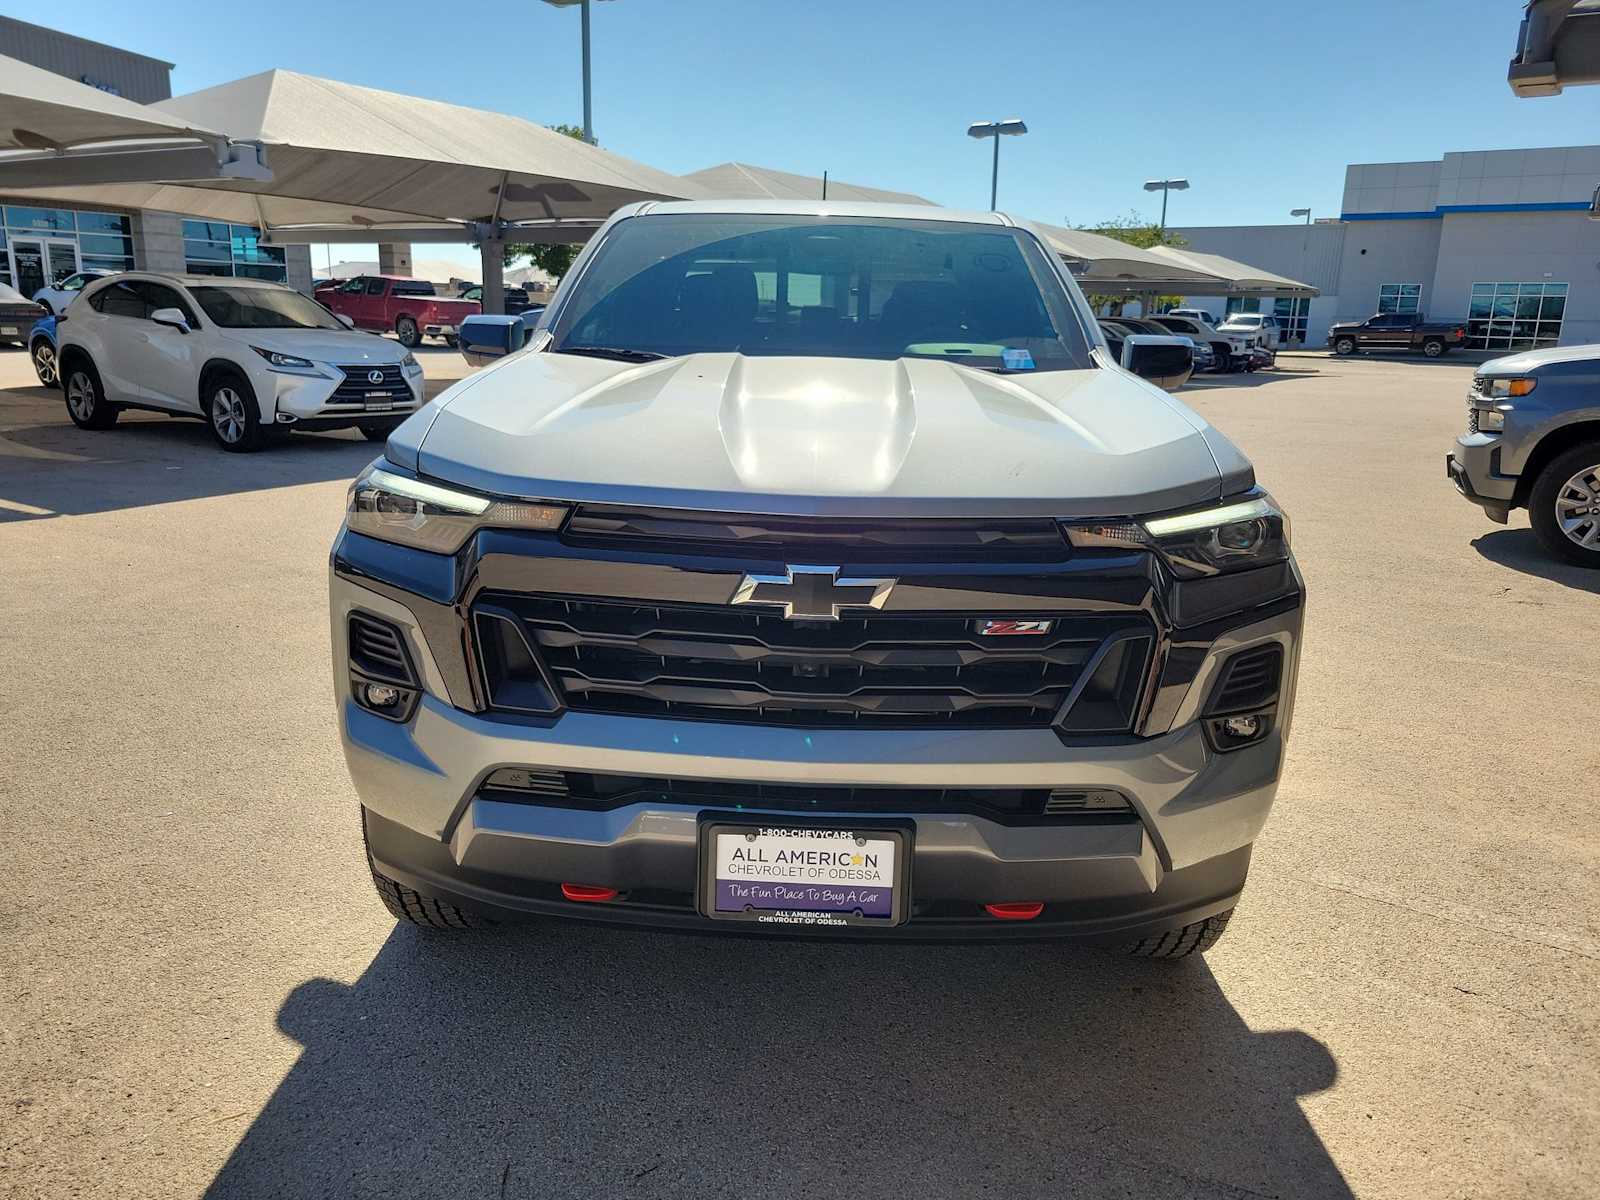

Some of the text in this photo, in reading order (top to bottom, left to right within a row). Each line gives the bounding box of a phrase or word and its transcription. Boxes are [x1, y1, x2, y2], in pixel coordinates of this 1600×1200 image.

[981, 620, 1051, 635] Z71
[758, 828, 854, 840] 1-800-CHEVYCARS
[732, 847, 878, 868] ALL AMERICN
[728, 863, 881, 881] CHEVROLET OF ODESSA
[728, 883, 879, 905] The Fun Place To Buy A Car
[758, 915, 803, 924] CHEVROLET
[817, 918, 848, 926] ODESSA
[791, 911, 831, 919] AMERICAN
